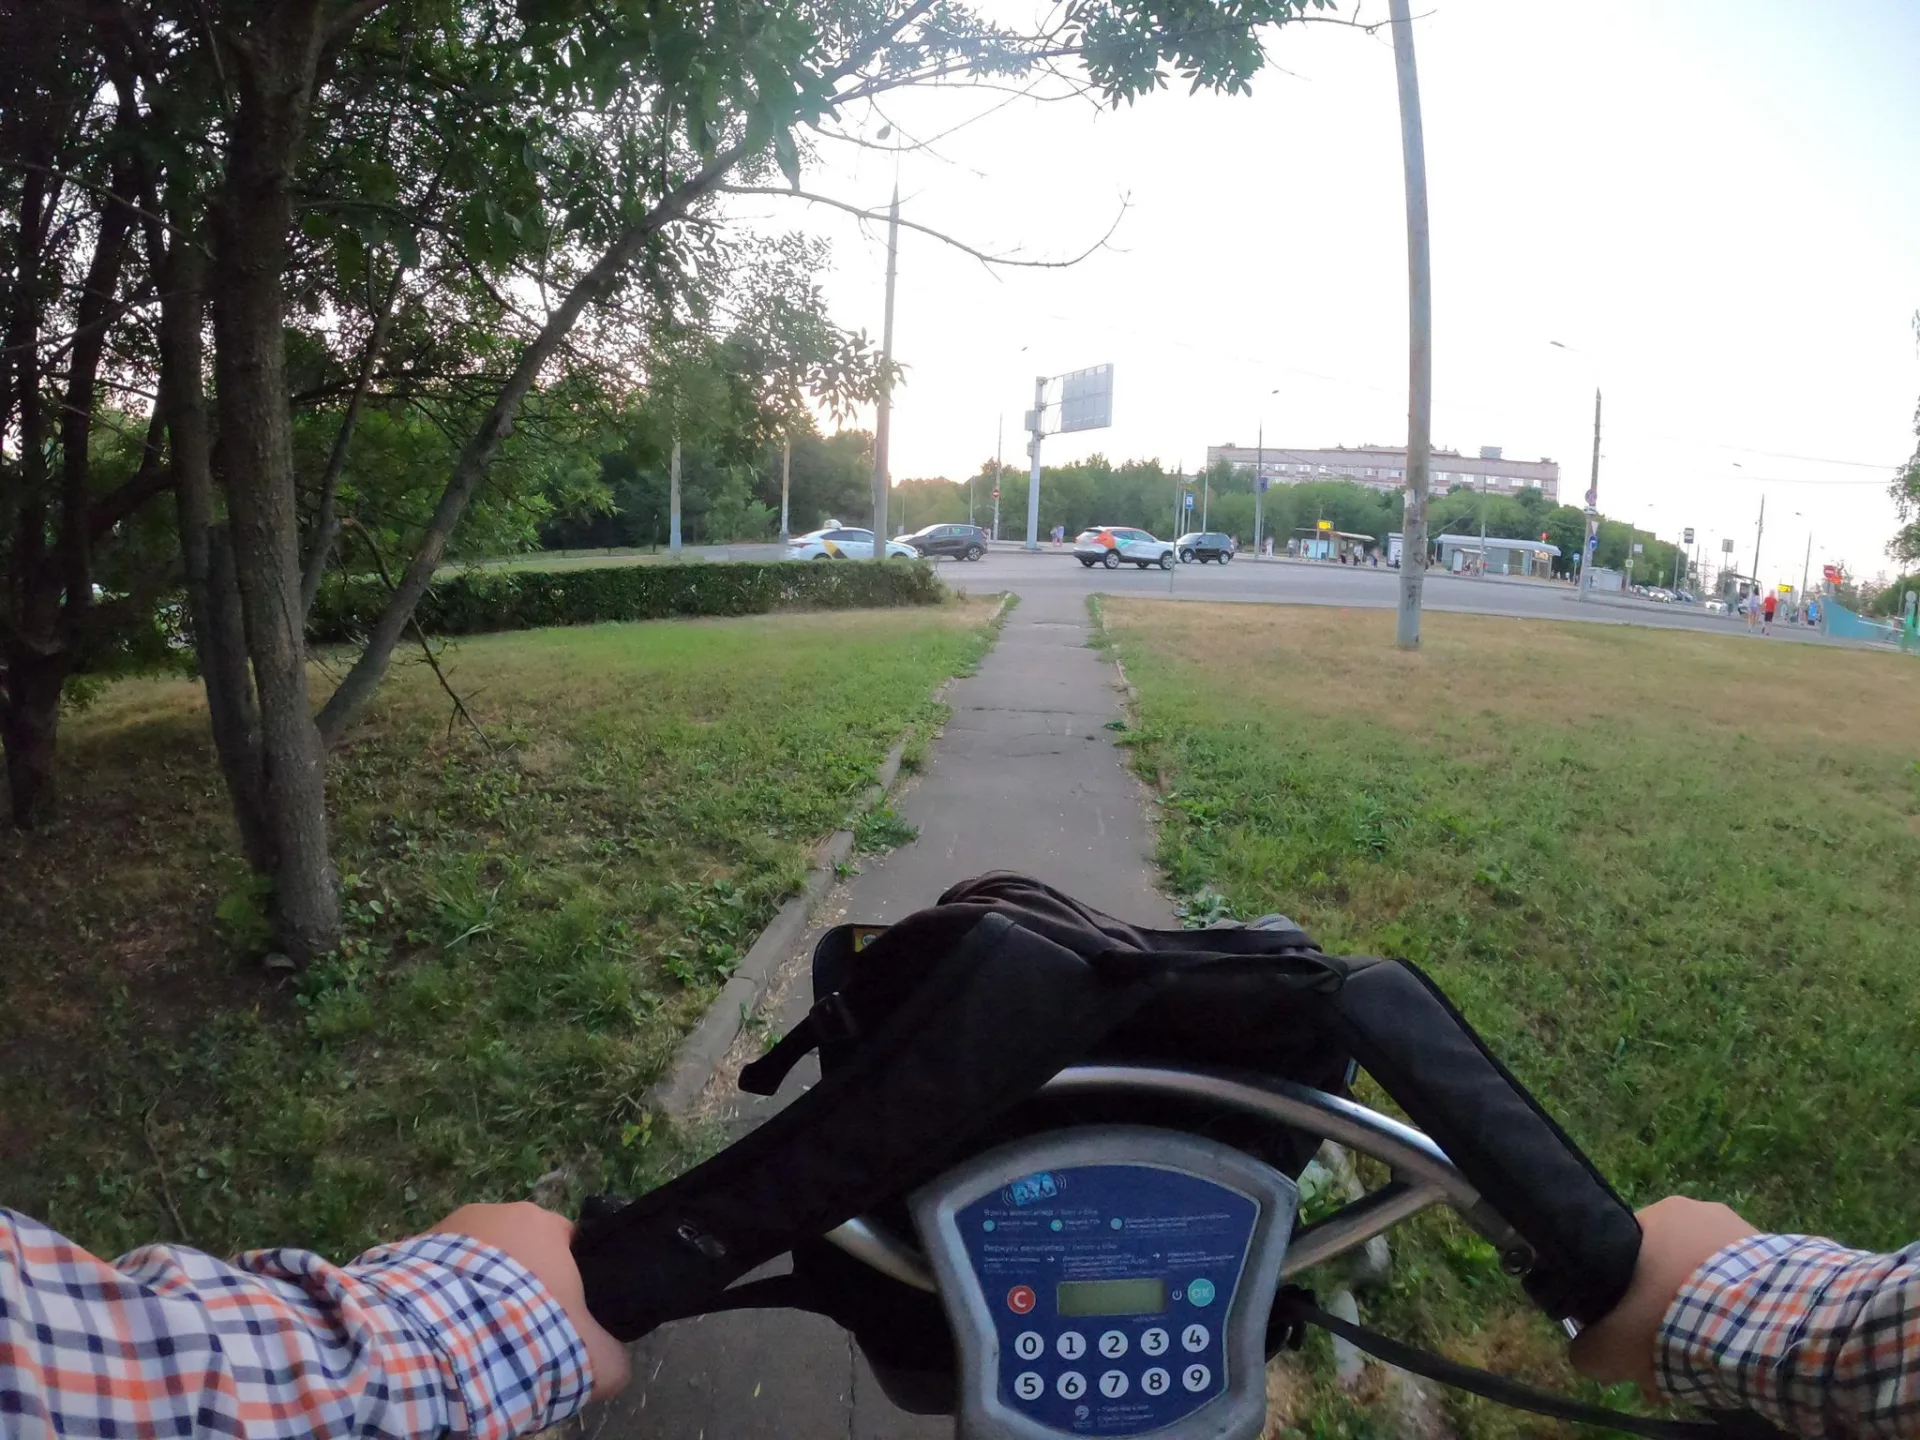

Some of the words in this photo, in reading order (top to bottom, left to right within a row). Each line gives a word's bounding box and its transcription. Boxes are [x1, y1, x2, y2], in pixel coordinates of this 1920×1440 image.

[1191, 1286, 1210, 1298] OK
[1023, 1337, 1036, 1354] 0
[1066, 1337, 1076, 1354] 1
[1108, 1336, 1120, 1352] 2
[1150, 1333, 1161, 1350] 3
[1189, 1330, 1201, 1346] 4
[1024, 1377, 1036, 1394] 5
[1065, 1377, 1078, 1394] 6
[1108, 1376, 1120, 1392] 7
[1150, 1373, 1162, 1390] 8
[1191, 1369, 1203, 1386] 9
